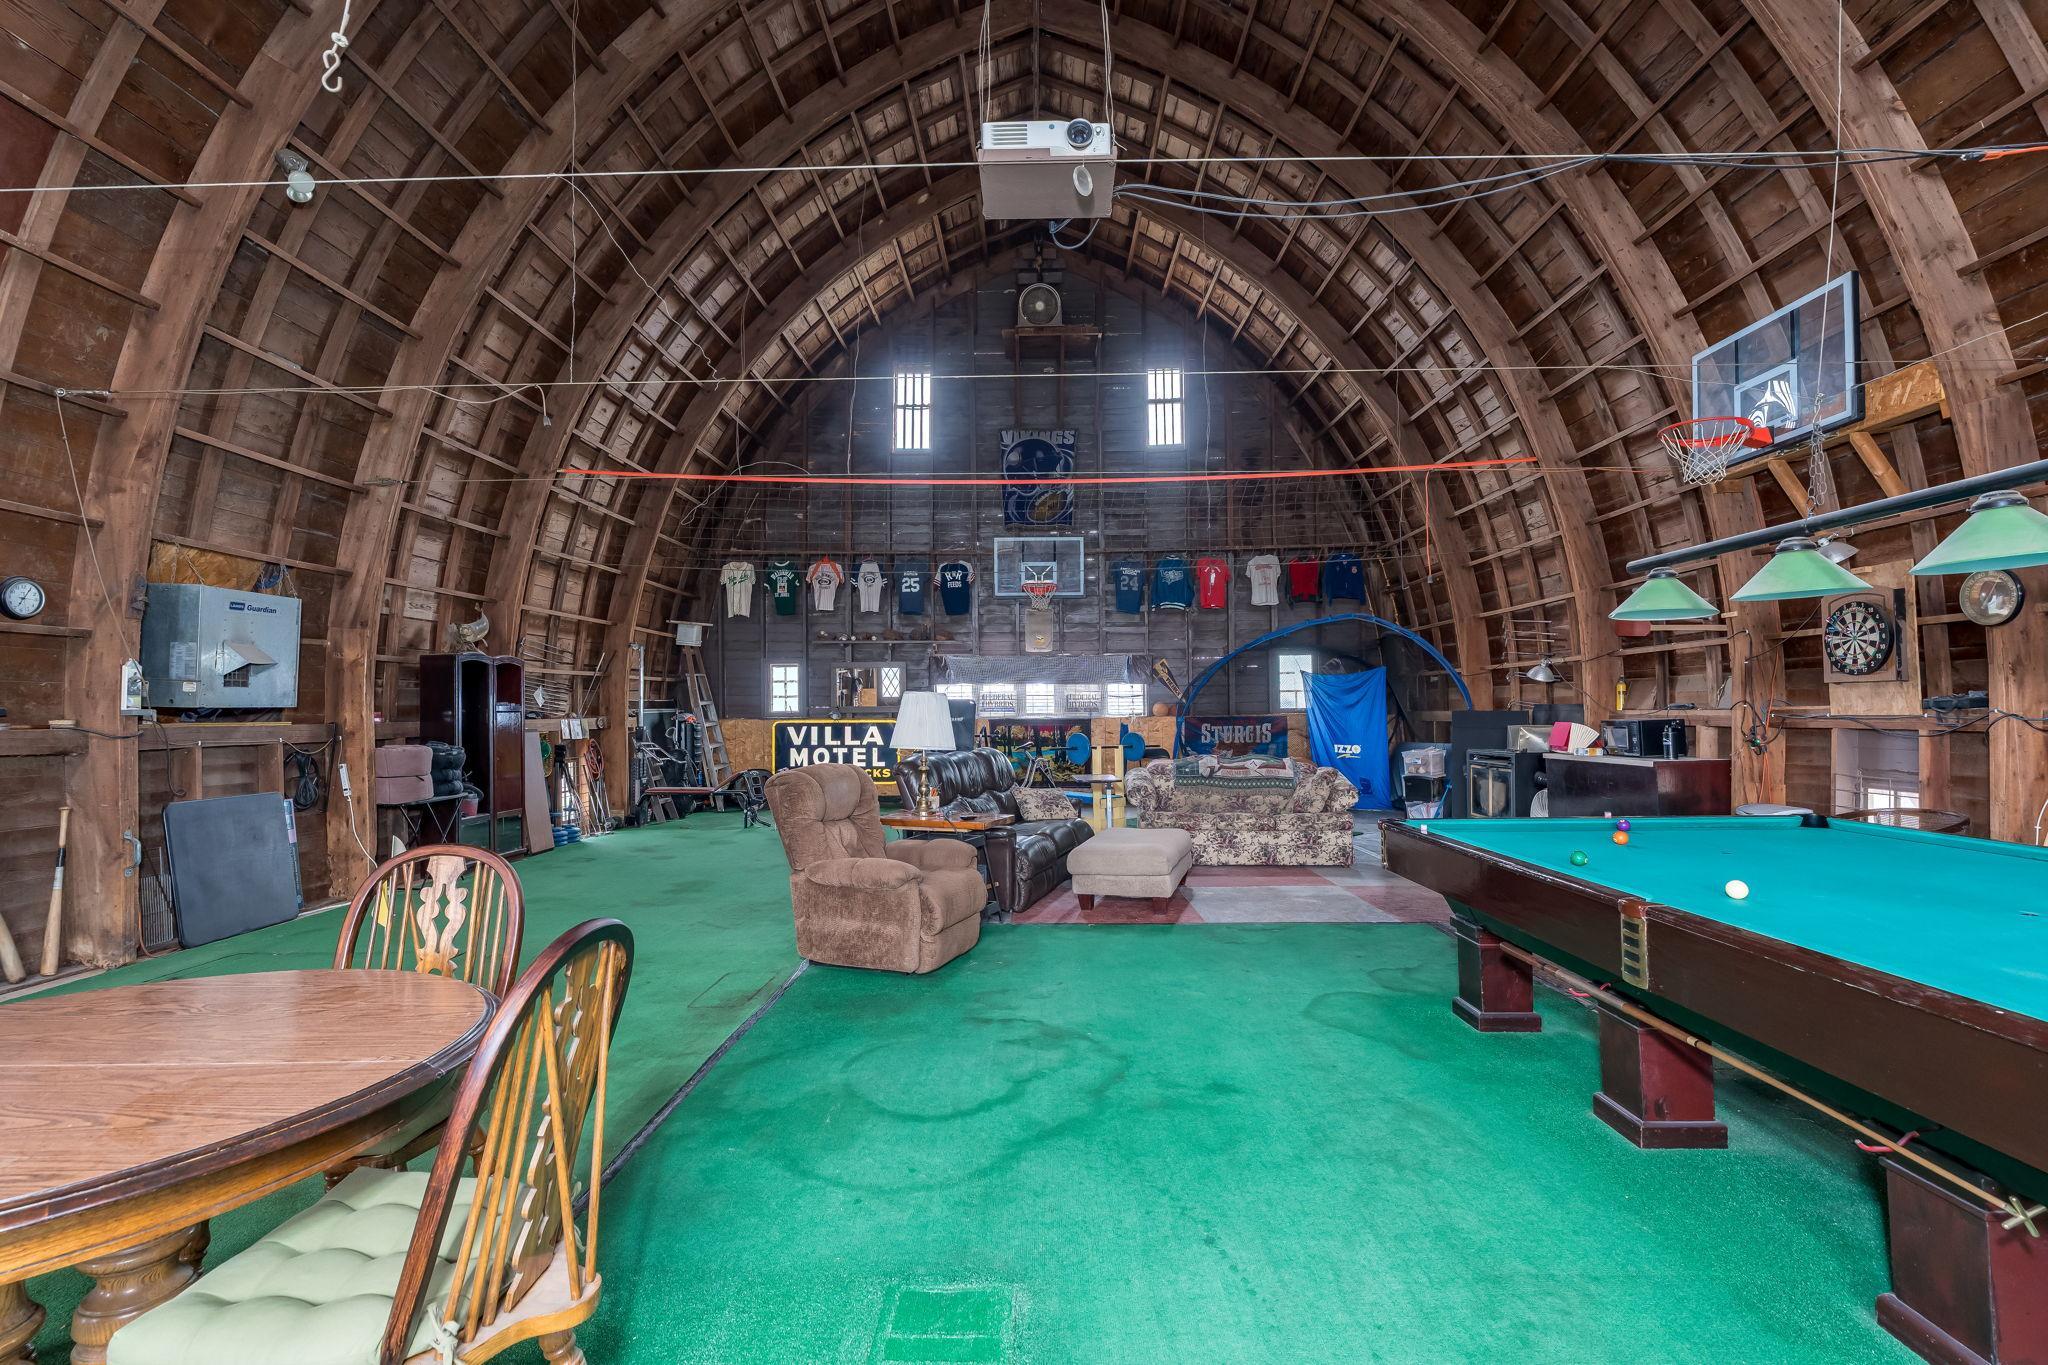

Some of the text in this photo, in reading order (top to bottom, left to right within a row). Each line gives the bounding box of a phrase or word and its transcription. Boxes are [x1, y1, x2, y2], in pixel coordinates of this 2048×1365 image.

[1001, 430, 1075, 445] VIKINGS
[901, 577, 920, 592] 25
[1120, 575, 1139, 591] 24
[246, 604, 277, 614] Guardian
[786, 725, 885, 746] VILLA
[1201, 722, 1272, 744] STURGIS
[1334, 744, 1362, 754] IZZO
[789, 747, 886, 767] MOTEL
